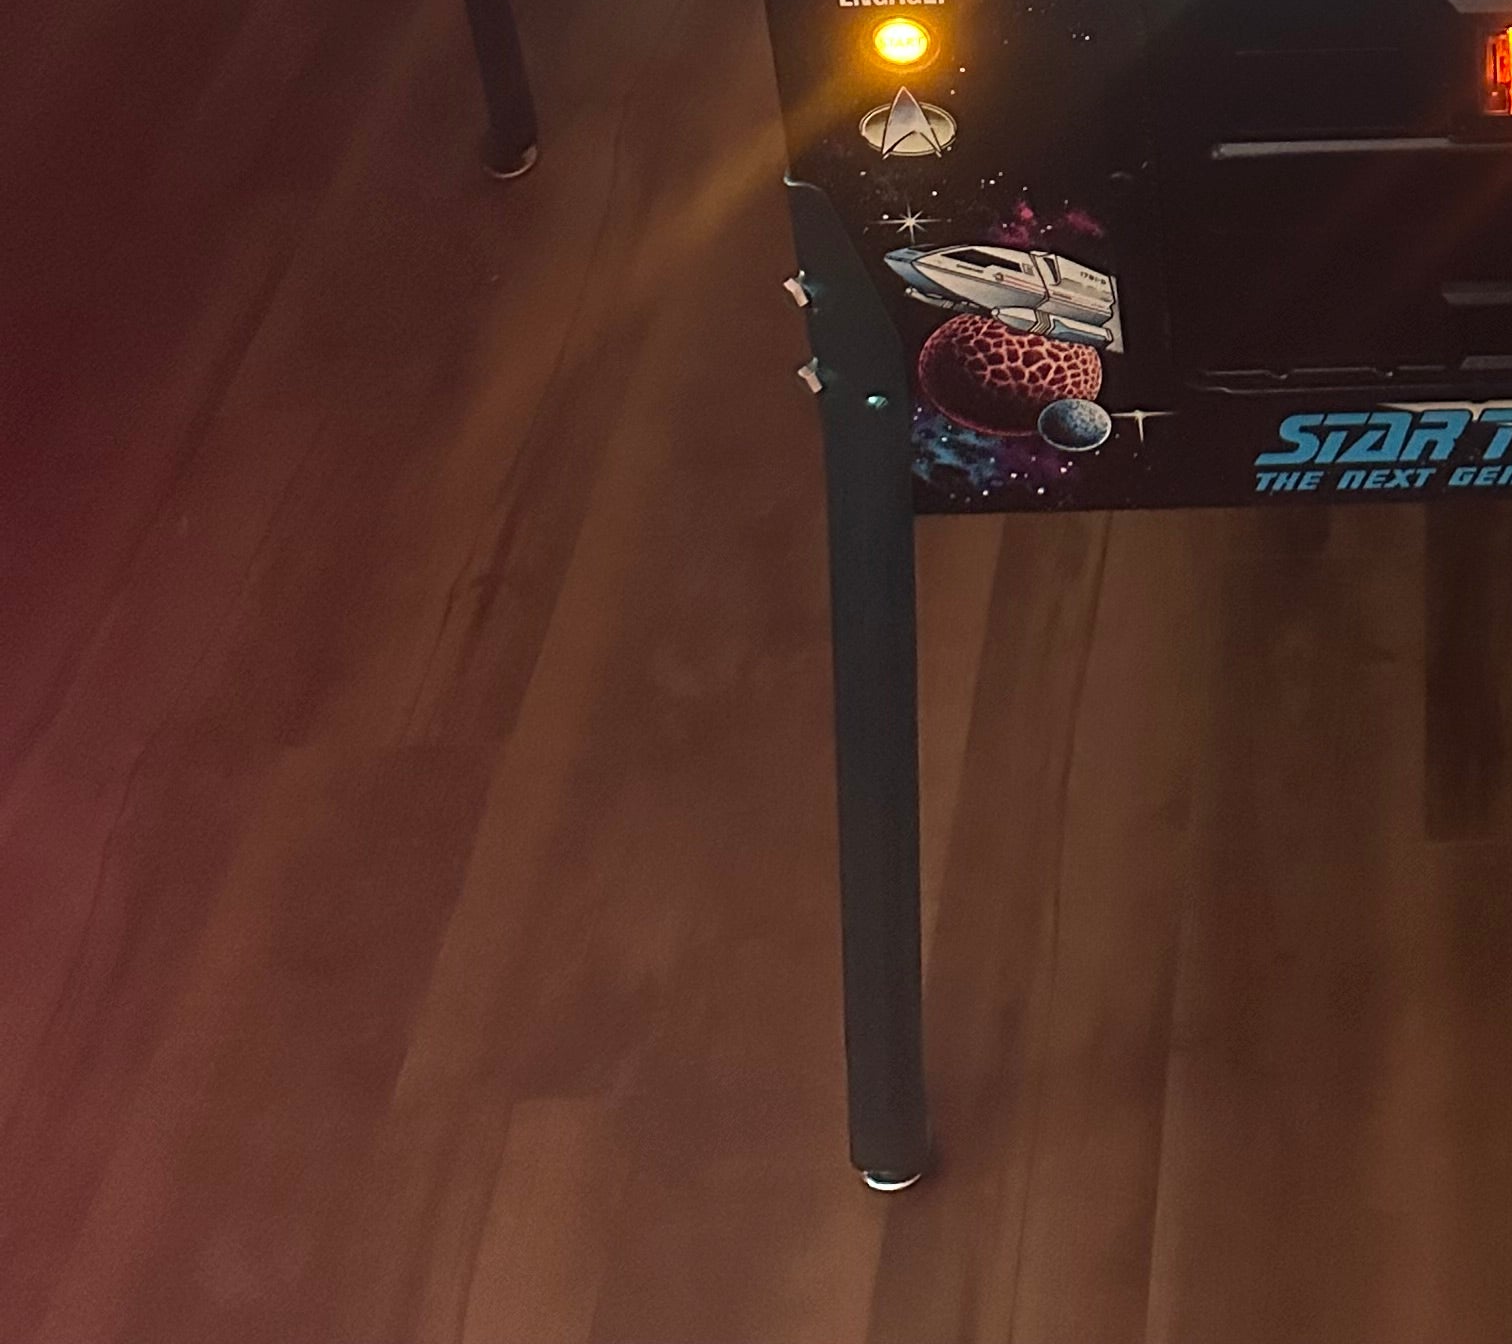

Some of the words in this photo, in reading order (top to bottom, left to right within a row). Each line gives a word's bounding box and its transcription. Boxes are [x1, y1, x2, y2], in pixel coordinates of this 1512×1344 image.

[1254, 408, 1474, 466] STAR
[1255, 469, 1325, 492] THE
[1336, 467, 1437, 490] NEXT
